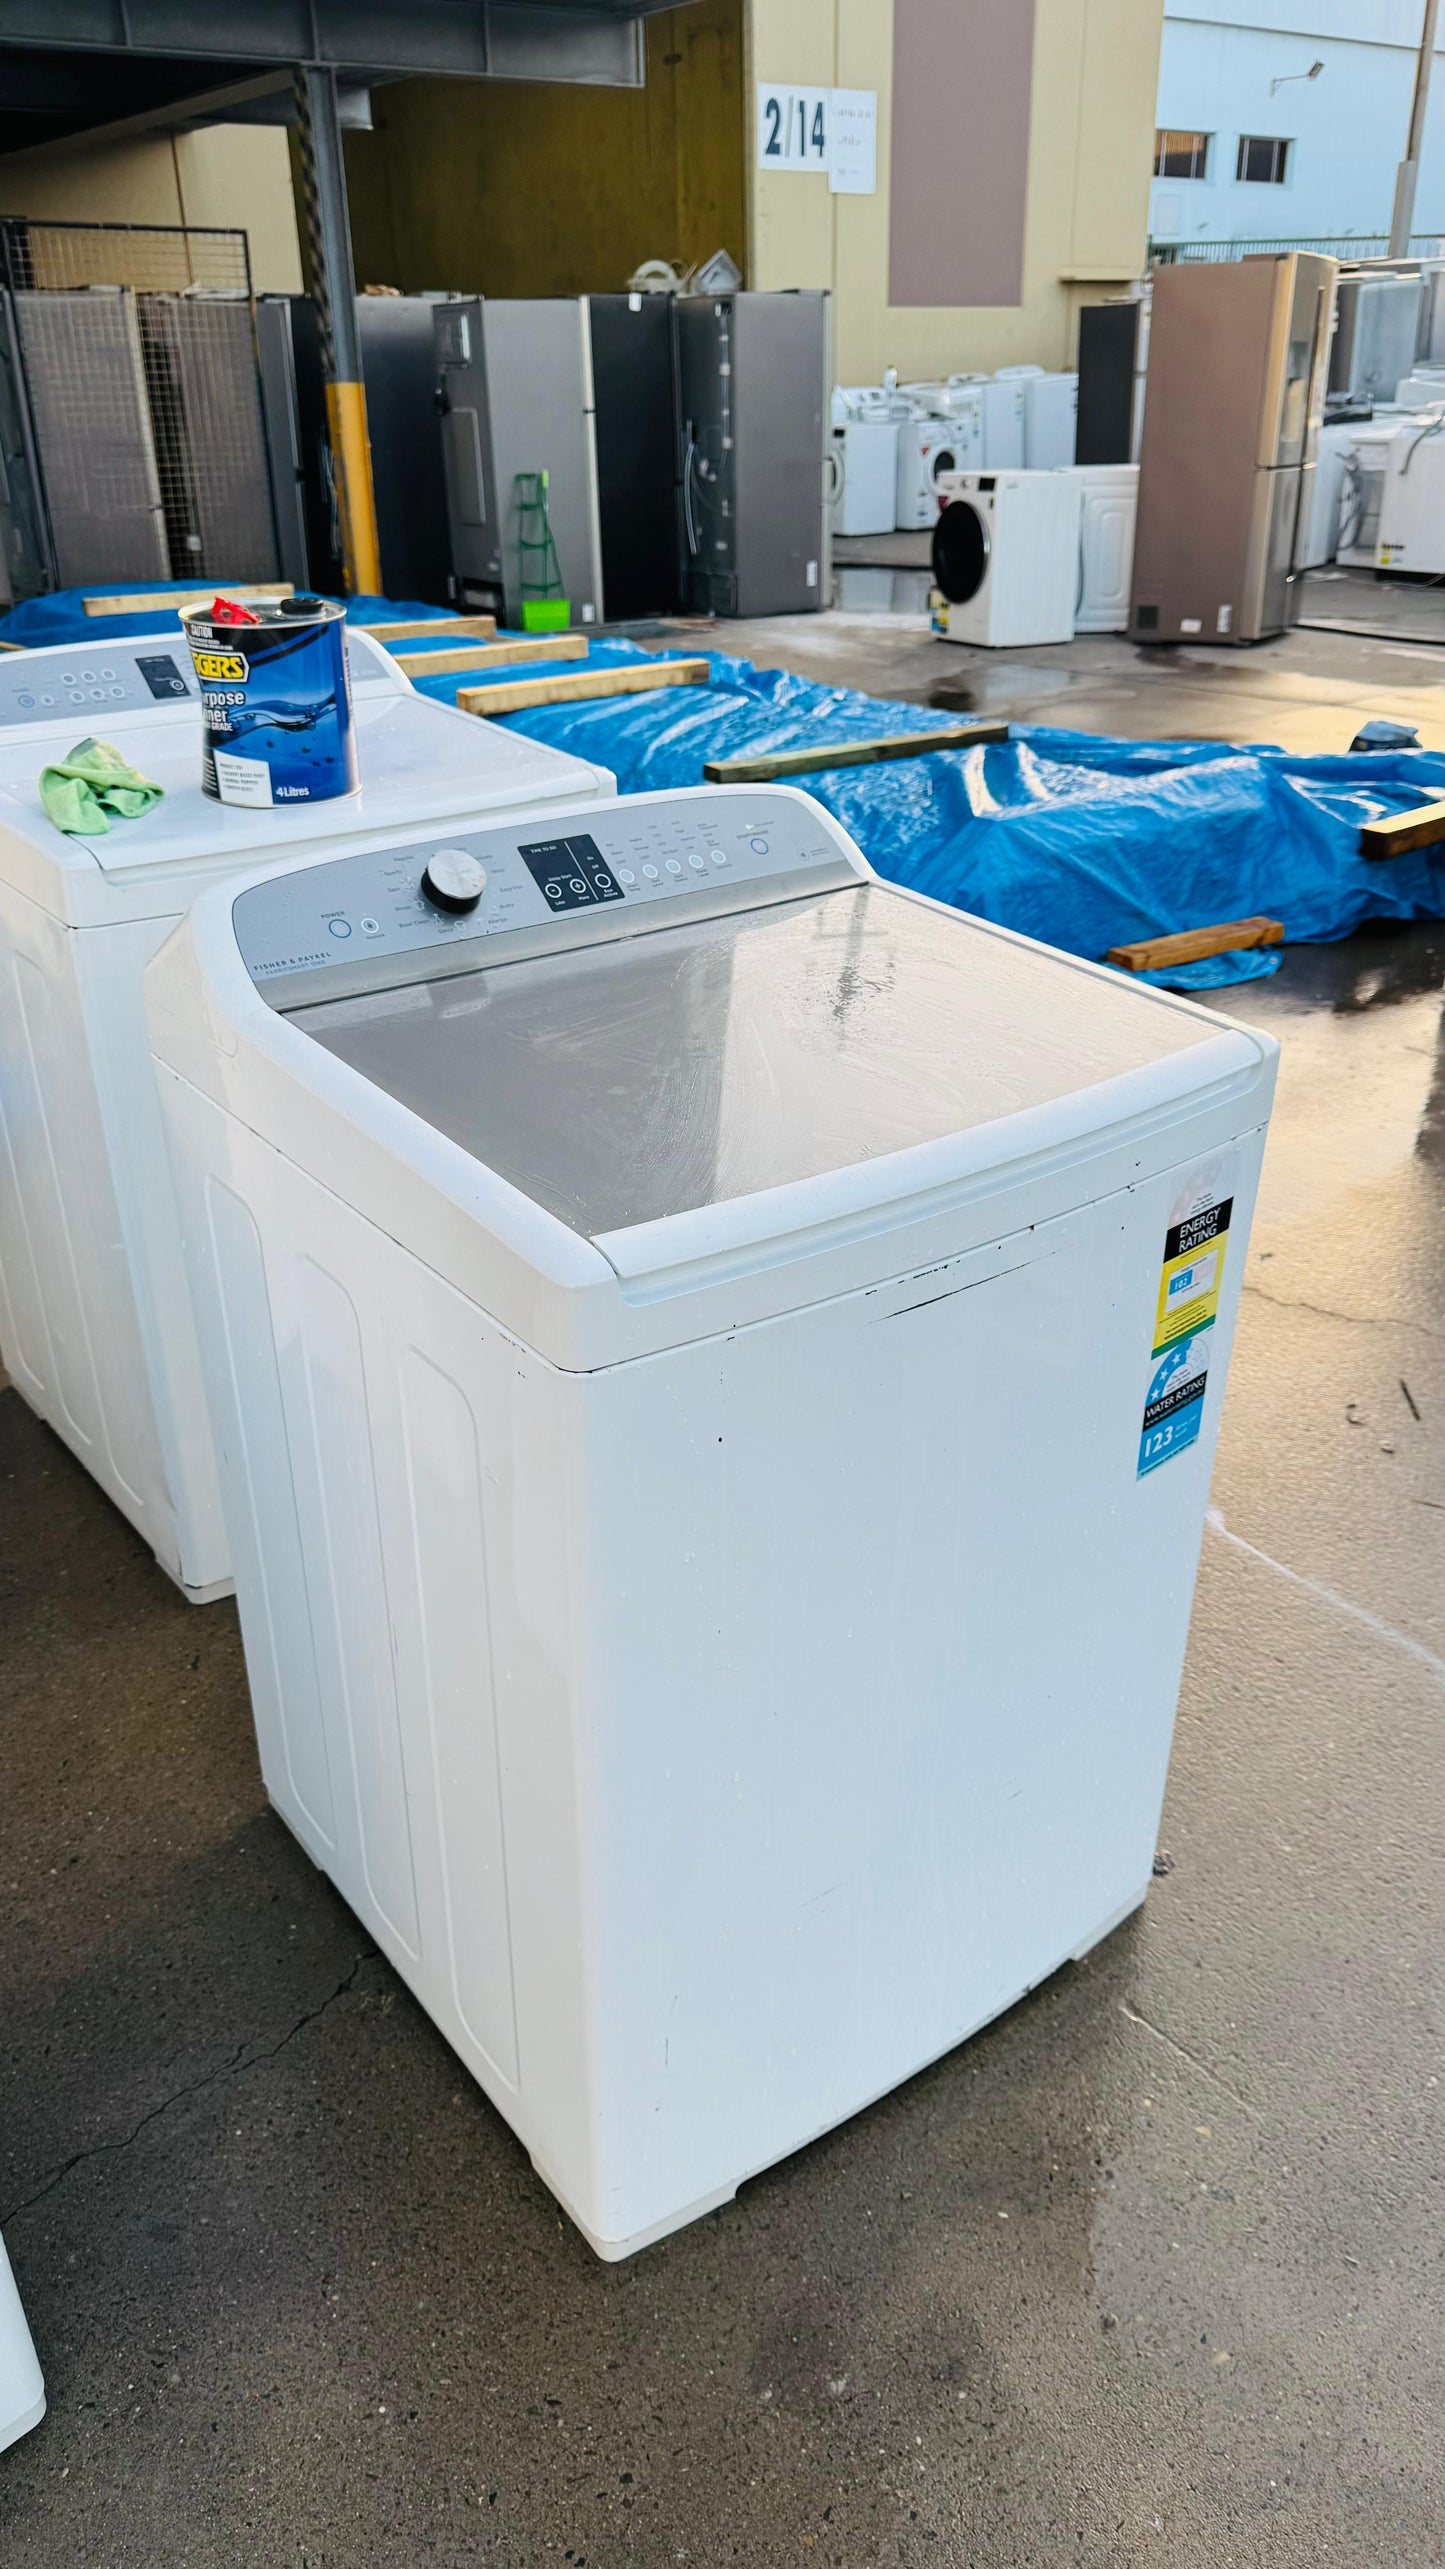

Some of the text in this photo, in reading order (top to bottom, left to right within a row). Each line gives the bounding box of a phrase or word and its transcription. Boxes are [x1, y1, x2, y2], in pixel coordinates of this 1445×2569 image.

[765, 96, 825, 158] 2/14
[191, 623, 213, 638] CAUTION
[254, 960, 287, 971] FISHER
[298, 951, 332, 962] PAYKEL
[1178, 1223, 1218, 1253] RATING
[1180, 1207, 1221, 1239] ENERGY
[1146, 1395, 1175, 1418] WATER
[1175, 1376, 1206, 1402] RATING
[1144, 1425, 1174, 1458] 123
